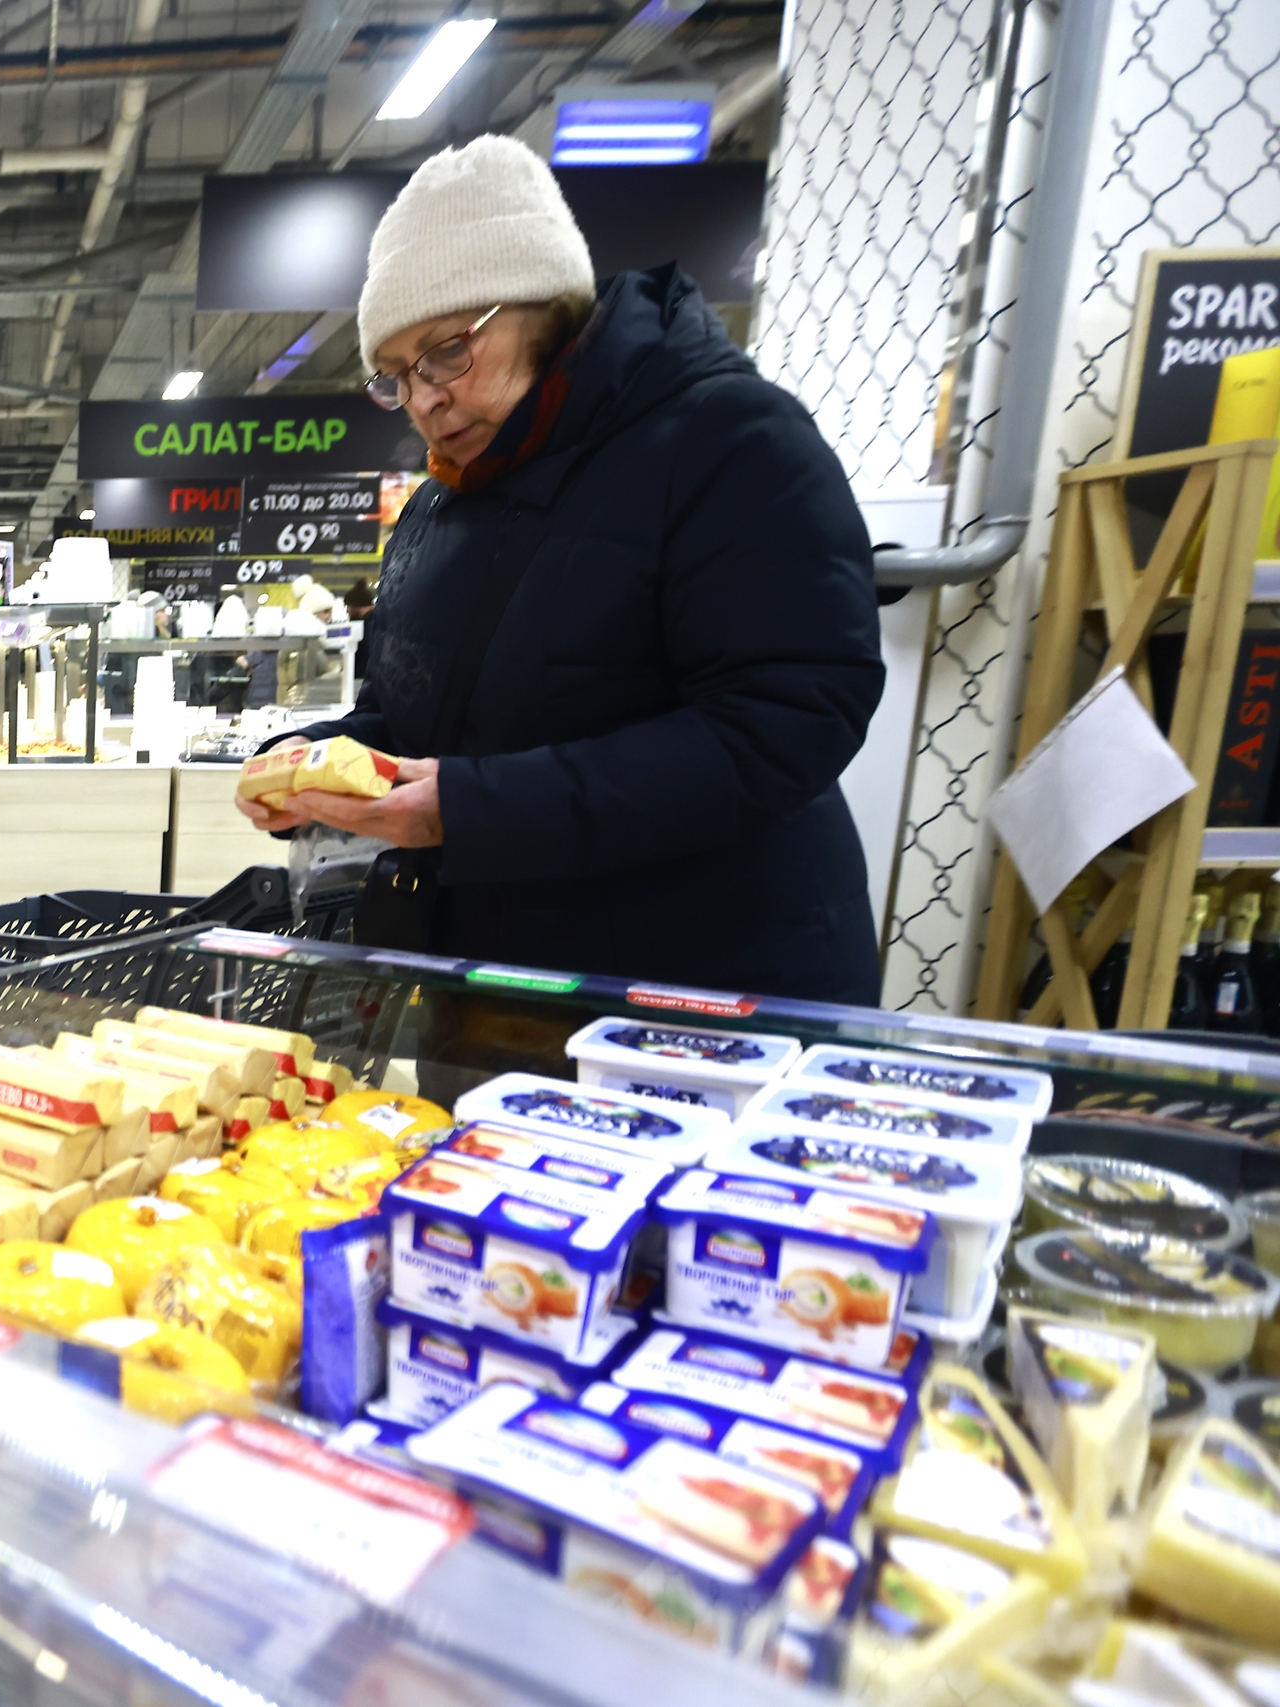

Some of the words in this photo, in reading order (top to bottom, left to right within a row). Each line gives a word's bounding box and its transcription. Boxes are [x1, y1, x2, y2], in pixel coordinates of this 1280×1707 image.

[1166, 282, 1279, 331] SPAR
[133, 418, 348, 457] САЛАТ-БАР
[170, 486, 241, 513] ГРИЛ
[263, 493, 301, 511] 11.00
[302, 496, 325, 512] до
[328, 492, 374, 510] 20.00
[276, 522, 318, 553] 69
[192, 567, 212, 577] 20.0
[236, 559, 268, 582] 69
[1226, 643, 1280, 772] ASTI
